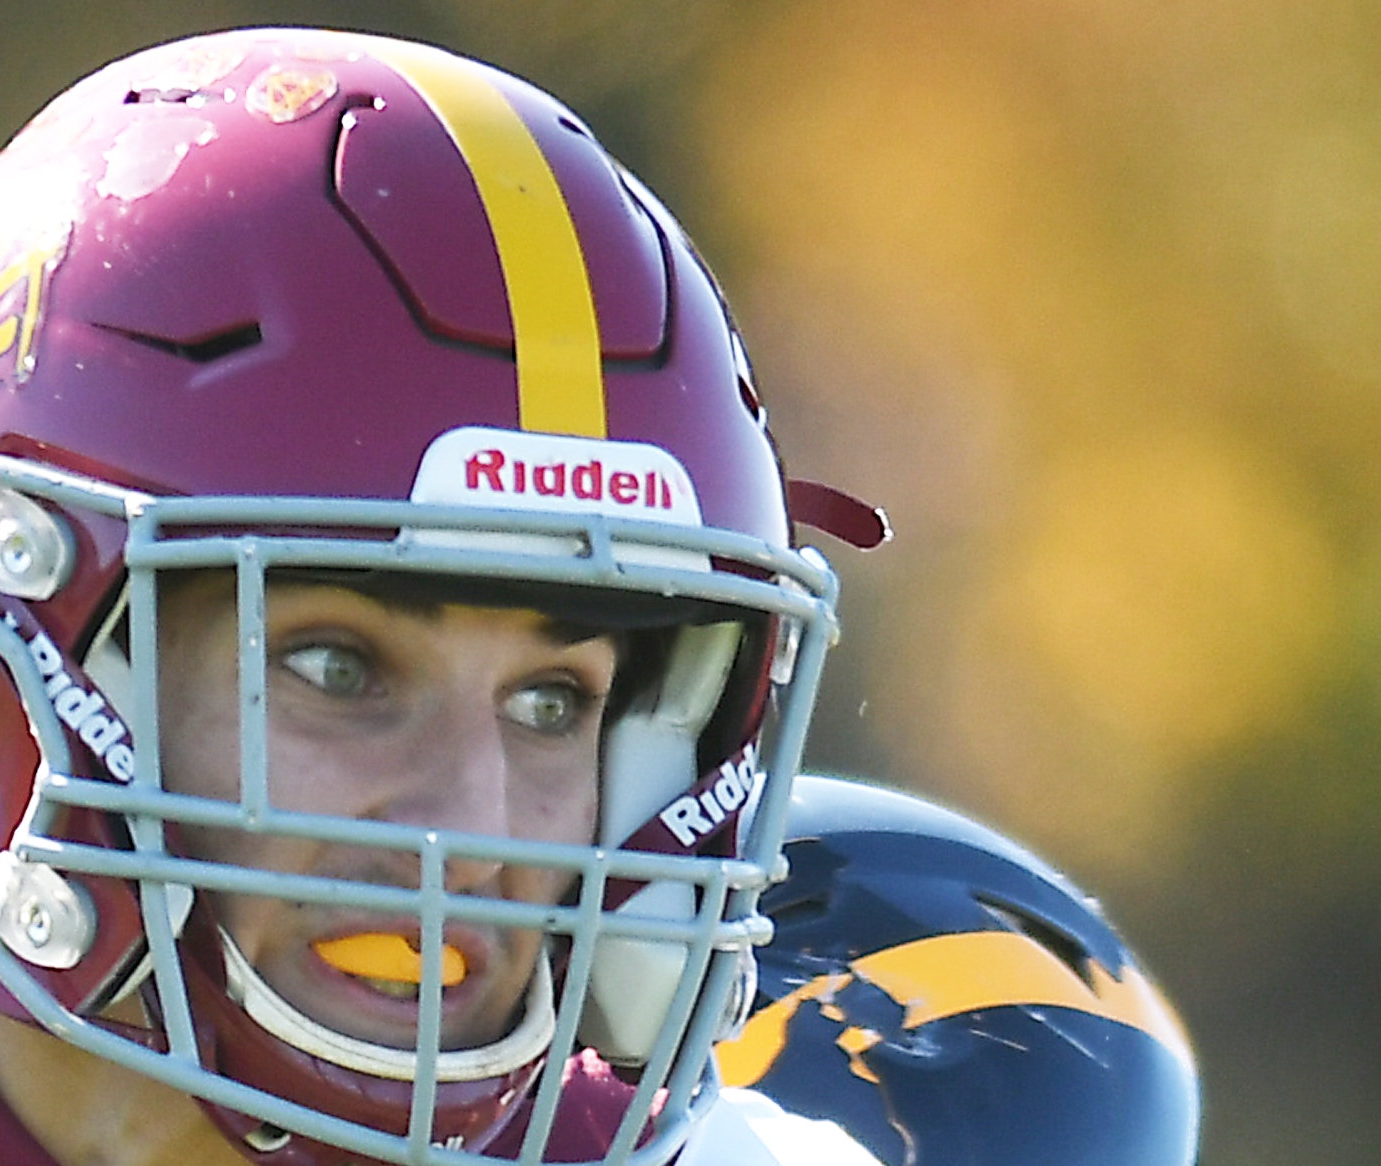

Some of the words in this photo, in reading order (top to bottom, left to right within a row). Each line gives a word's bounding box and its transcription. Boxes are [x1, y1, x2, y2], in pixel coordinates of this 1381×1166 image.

[464, 448, 674, 510] Riddell
[28, 630, 135, 783] Ridde
[659, 742, 757, 848] Ridd
